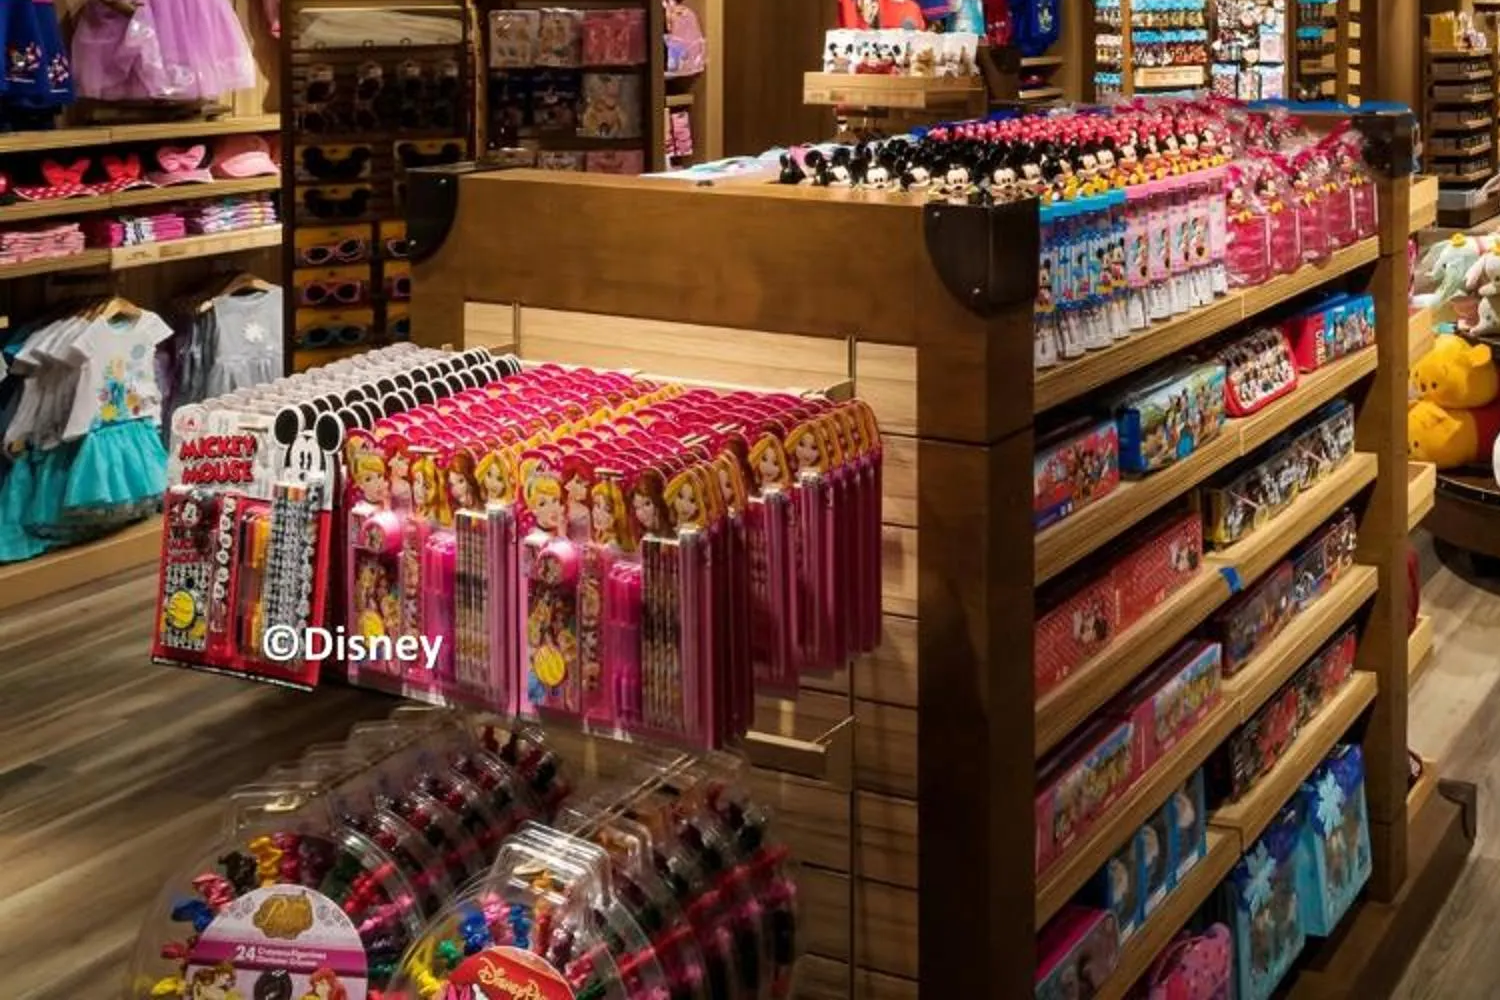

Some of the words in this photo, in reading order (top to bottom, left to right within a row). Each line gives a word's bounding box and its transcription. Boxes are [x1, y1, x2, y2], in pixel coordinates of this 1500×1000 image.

[179, 435, 259, 460] MICKEY
[182, 460, 254, 485] MOUSE
[235, 944, 257, 962] 24
